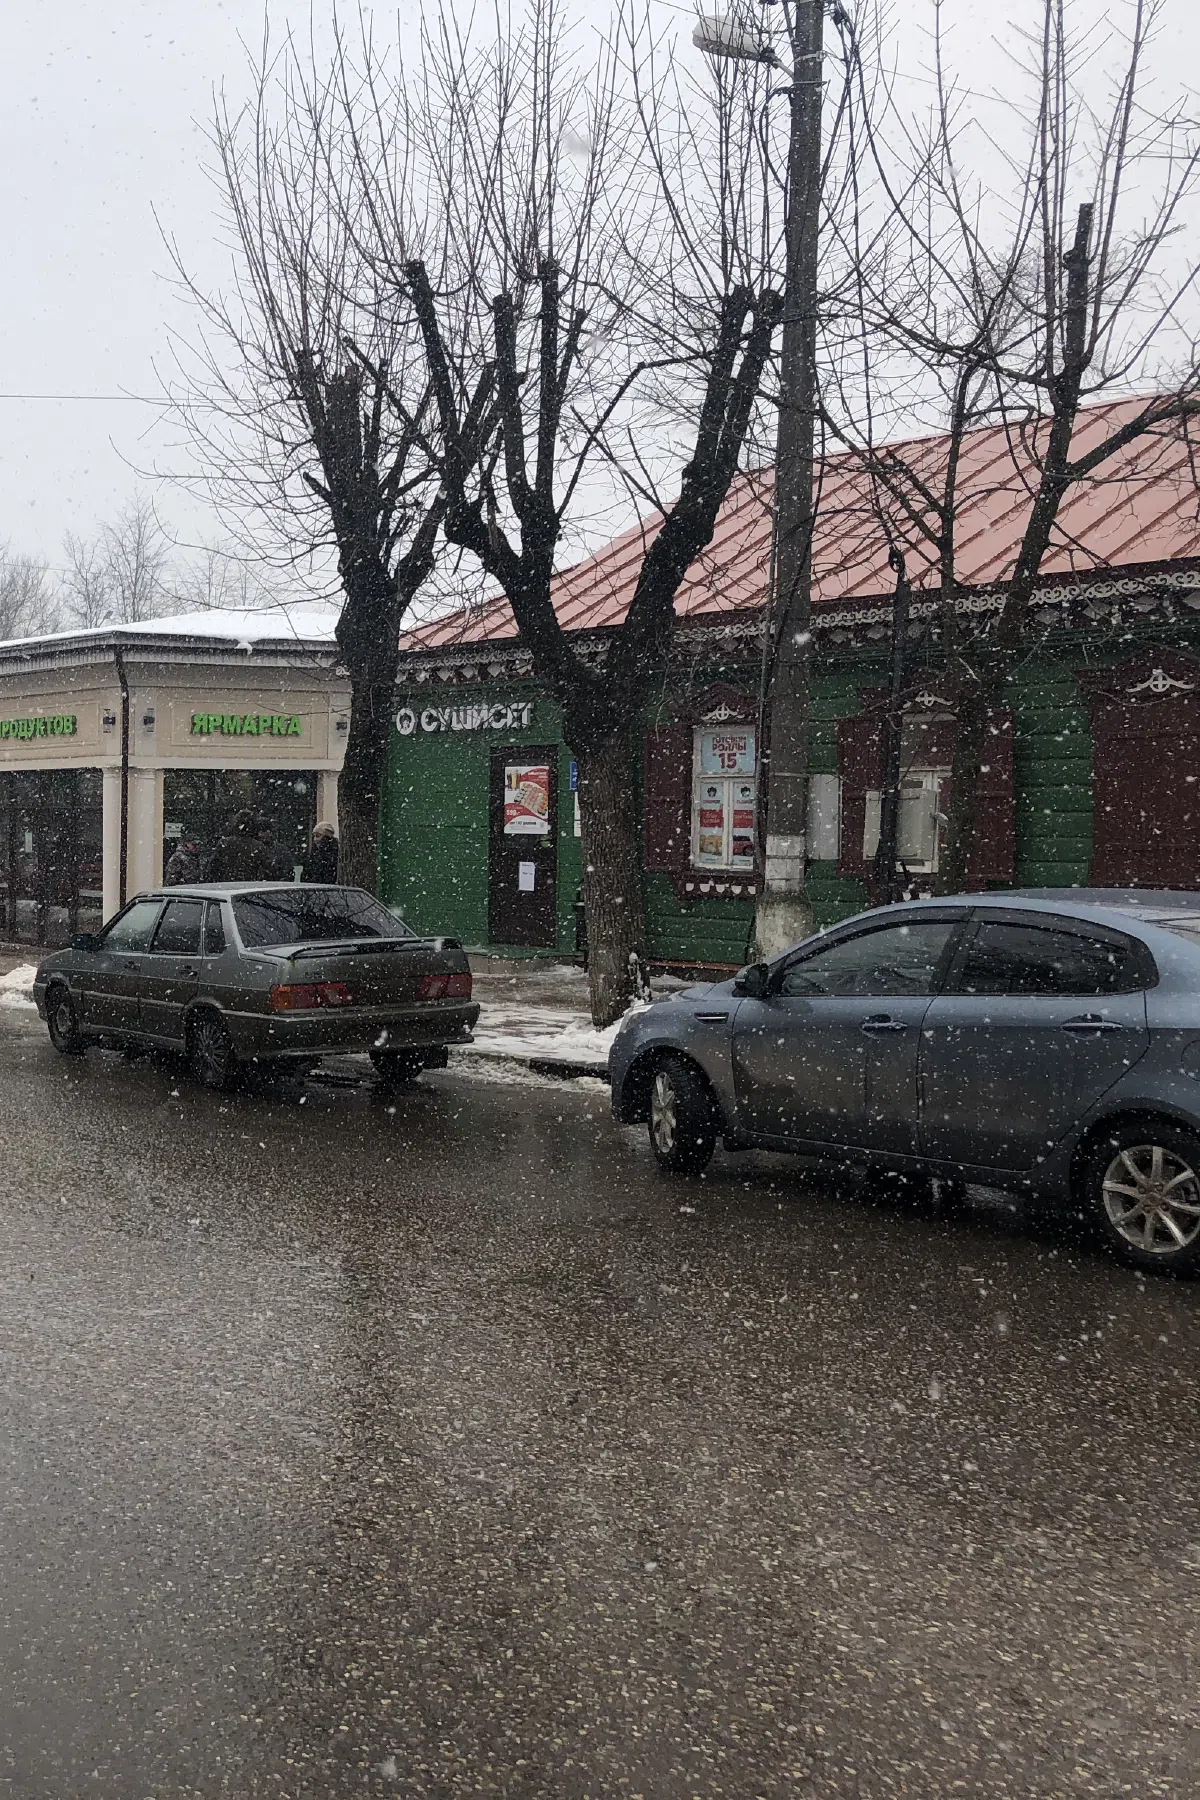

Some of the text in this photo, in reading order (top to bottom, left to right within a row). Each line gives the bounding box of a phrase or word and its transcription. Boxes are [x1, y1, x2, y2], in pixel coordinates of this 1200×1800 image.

[192, 713, 302, 737] ЯРМАРКА
[712, 742, 747, 752] РОЛЛЫ
[719, 752, 737, 769] 15
